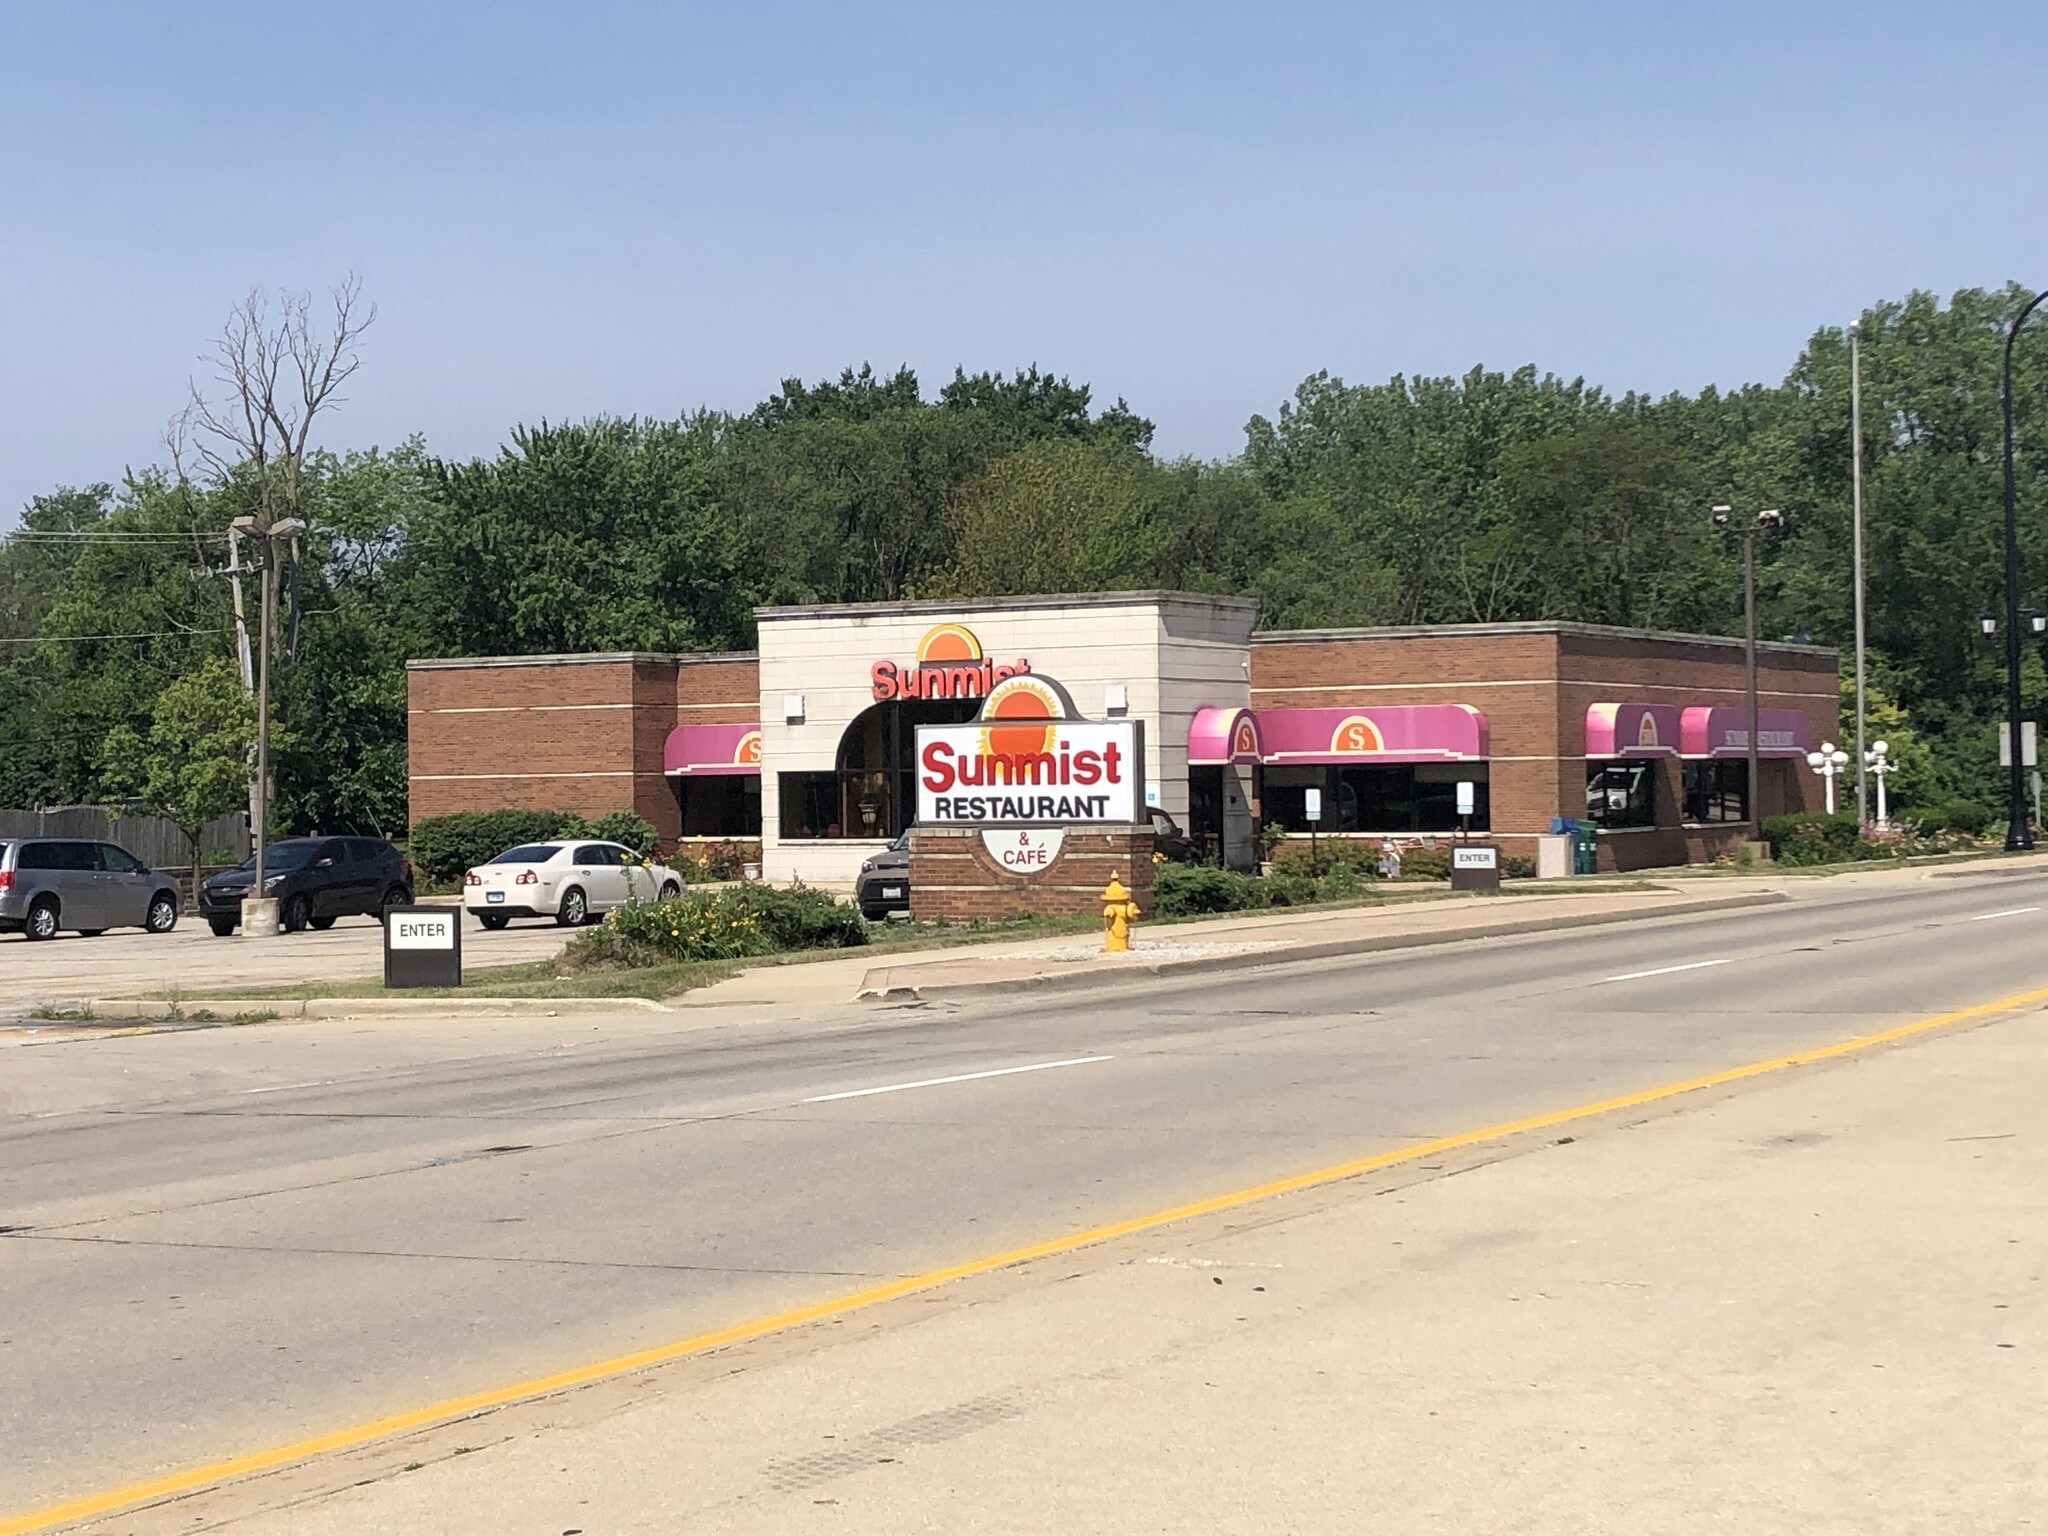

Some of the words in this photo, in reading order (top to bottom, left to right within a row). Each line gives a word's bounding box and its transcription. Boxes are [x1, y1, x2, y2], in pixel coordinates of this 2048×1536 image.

[1241, 728, 1250, 750] S
[1348, 726, 1365, 749] S
[922, 741, 1121, 793] Sunmist
[935, 795, 1110, 819] RESTAURANT
[1019, 832, 1030, 846] &
[1003, 842, 1047, 865] CAFÉ
[1459, 853, 1490, 863] ENTER
[400, 923, 445, 937] ENTER
